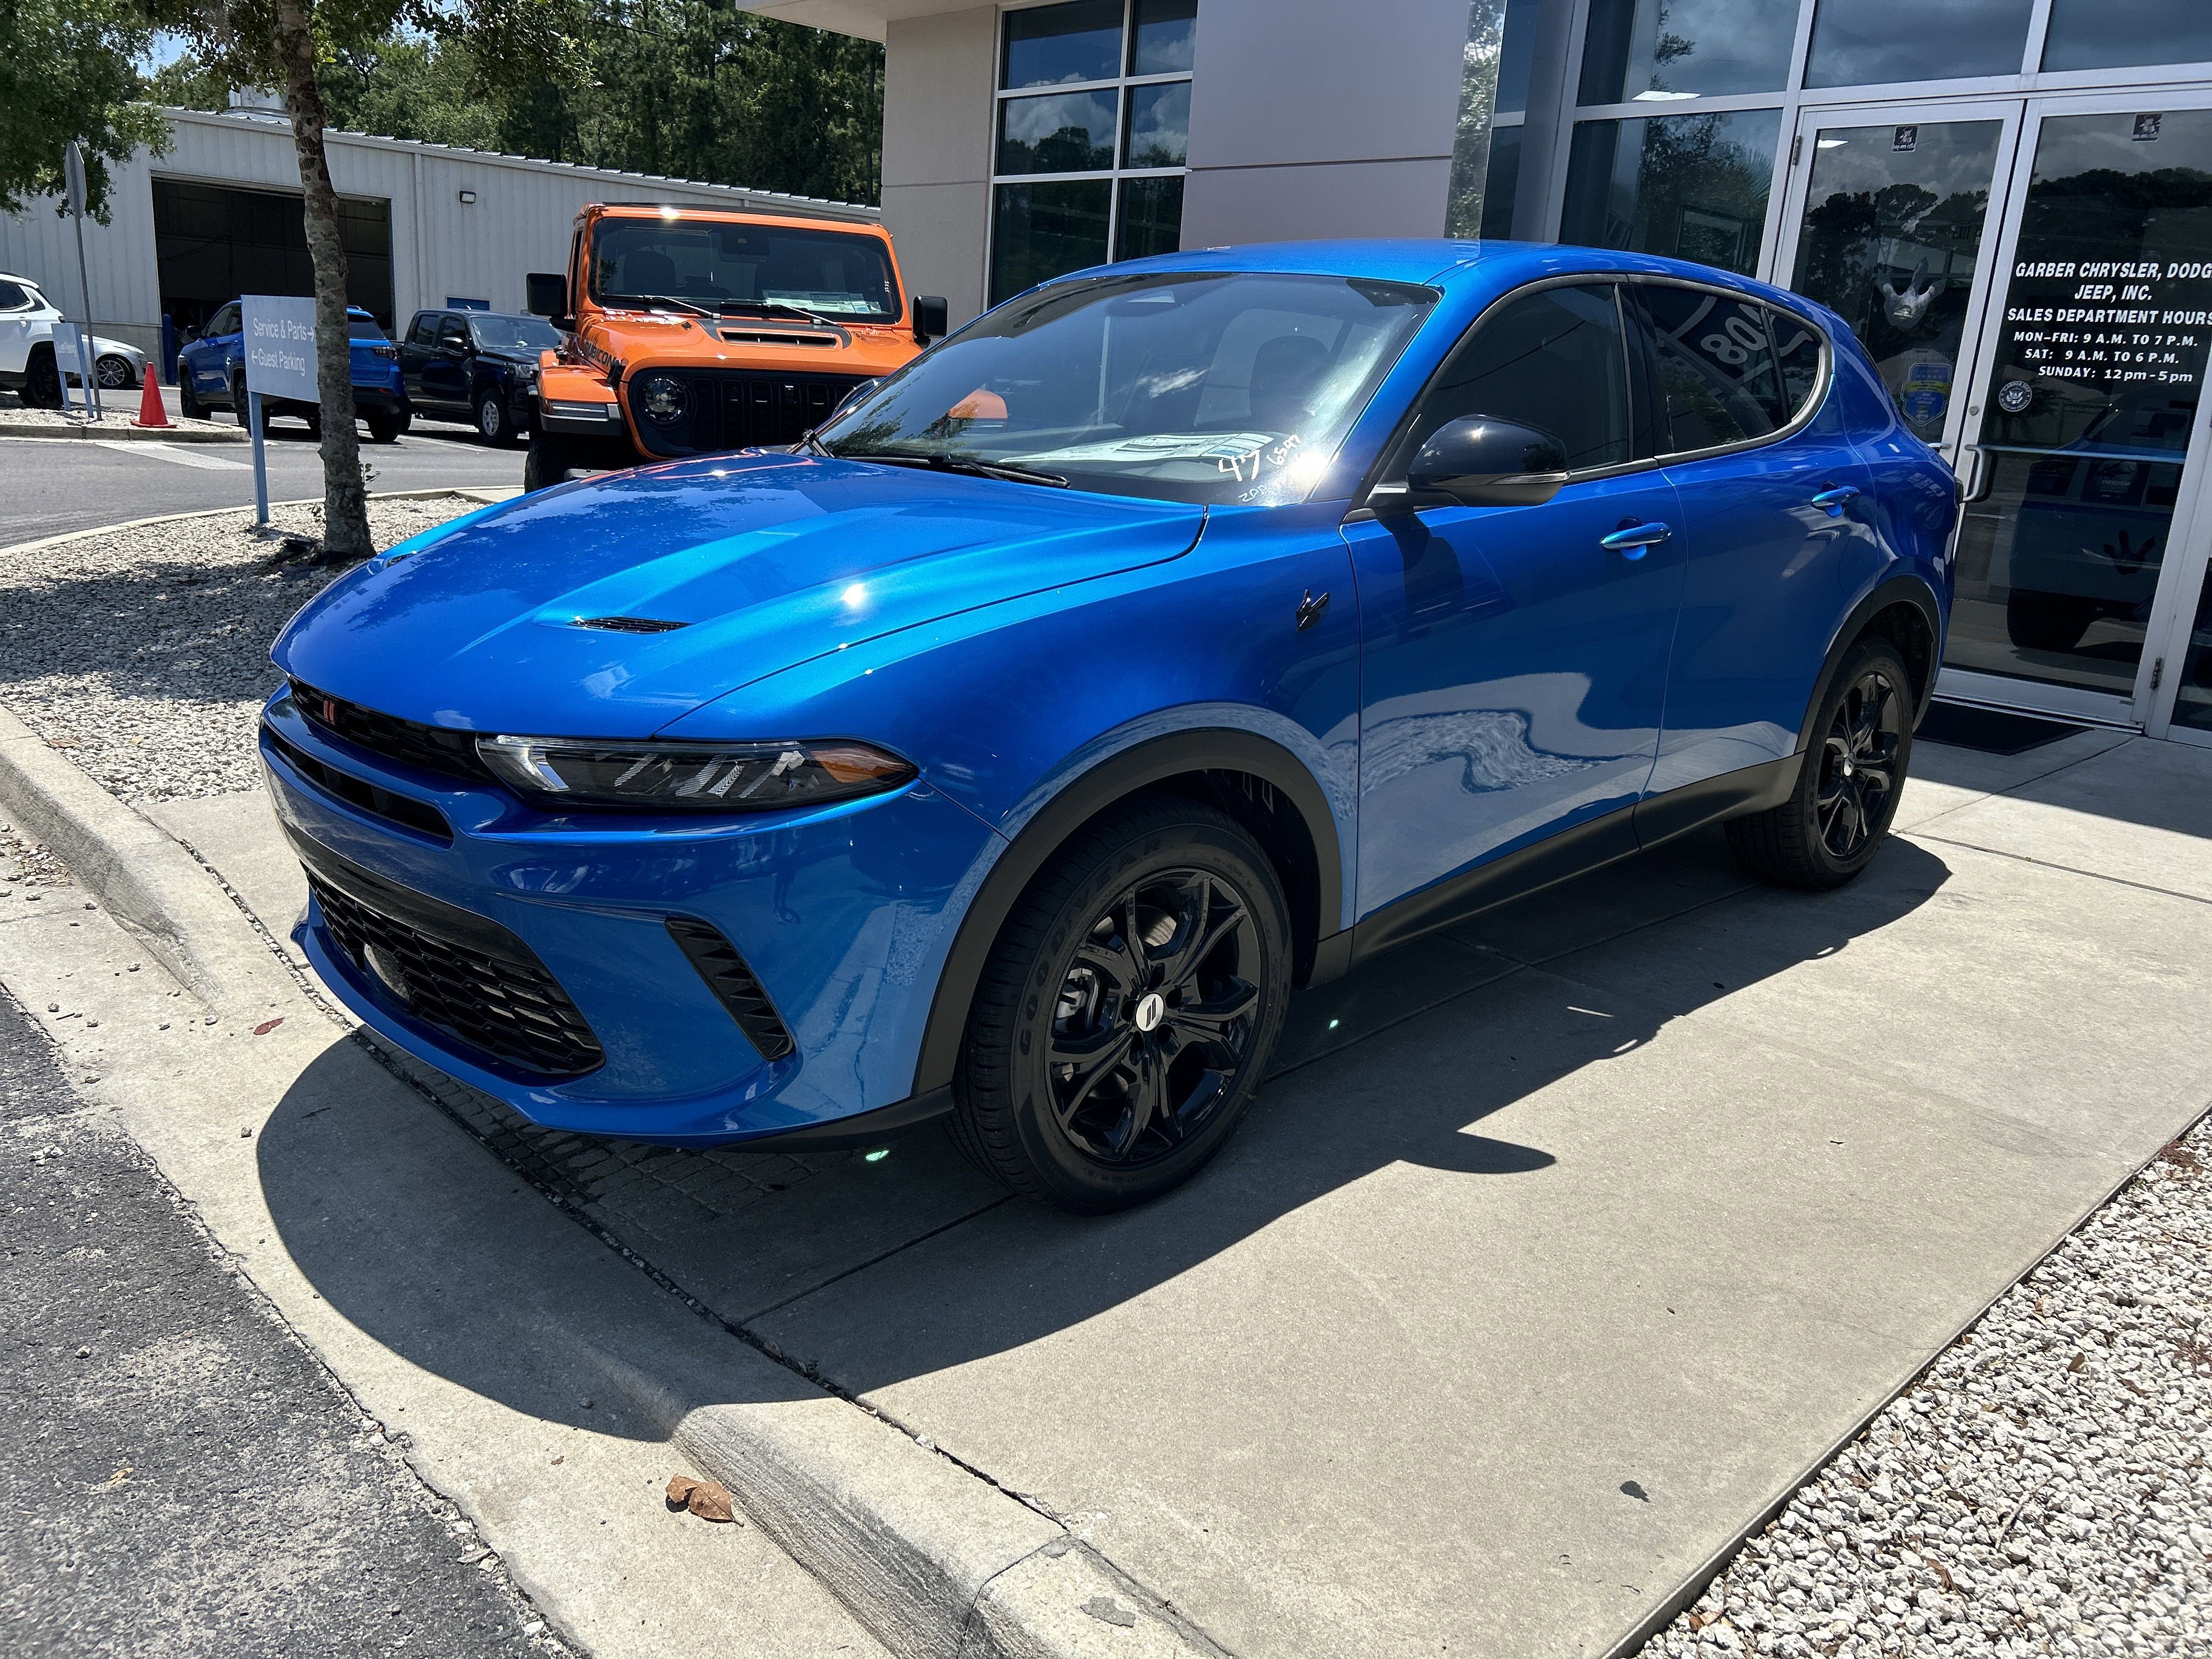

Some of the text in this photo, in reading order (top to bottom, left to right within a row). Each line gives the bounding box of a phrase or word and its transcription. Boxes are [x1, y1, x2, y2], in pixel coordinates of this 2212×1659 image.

[2016, 262, 2212, 281] GARBER CHRYSLER, DODG
[2074, 285, 2152, 303] JEEP, INC.
[2007, 308, 2053, 321] SALES
[2056, 309, 2159, 324] DEPARTMENT
[253, 318, 307, 341] Service & Parts
[2083, 333, 2091, 343] 9
[2095, 334, 2126, 344] A.M.
[2132, 334, 2149, 345] TO
[2154, 335, 2163, 345] 7
[2167, 335, 2198, 346] P.M.
[258, 348, 306, 377] Guest Parking
[2024, 348, 2179, 364] SAT: 9 A.M. TO 6 P.M.
[2038, 366, 2096, 378] SUNDAY:
[1218, 449, 1261, 482] 47
[1019, 838, 1162, 1056] GOODYEAR
